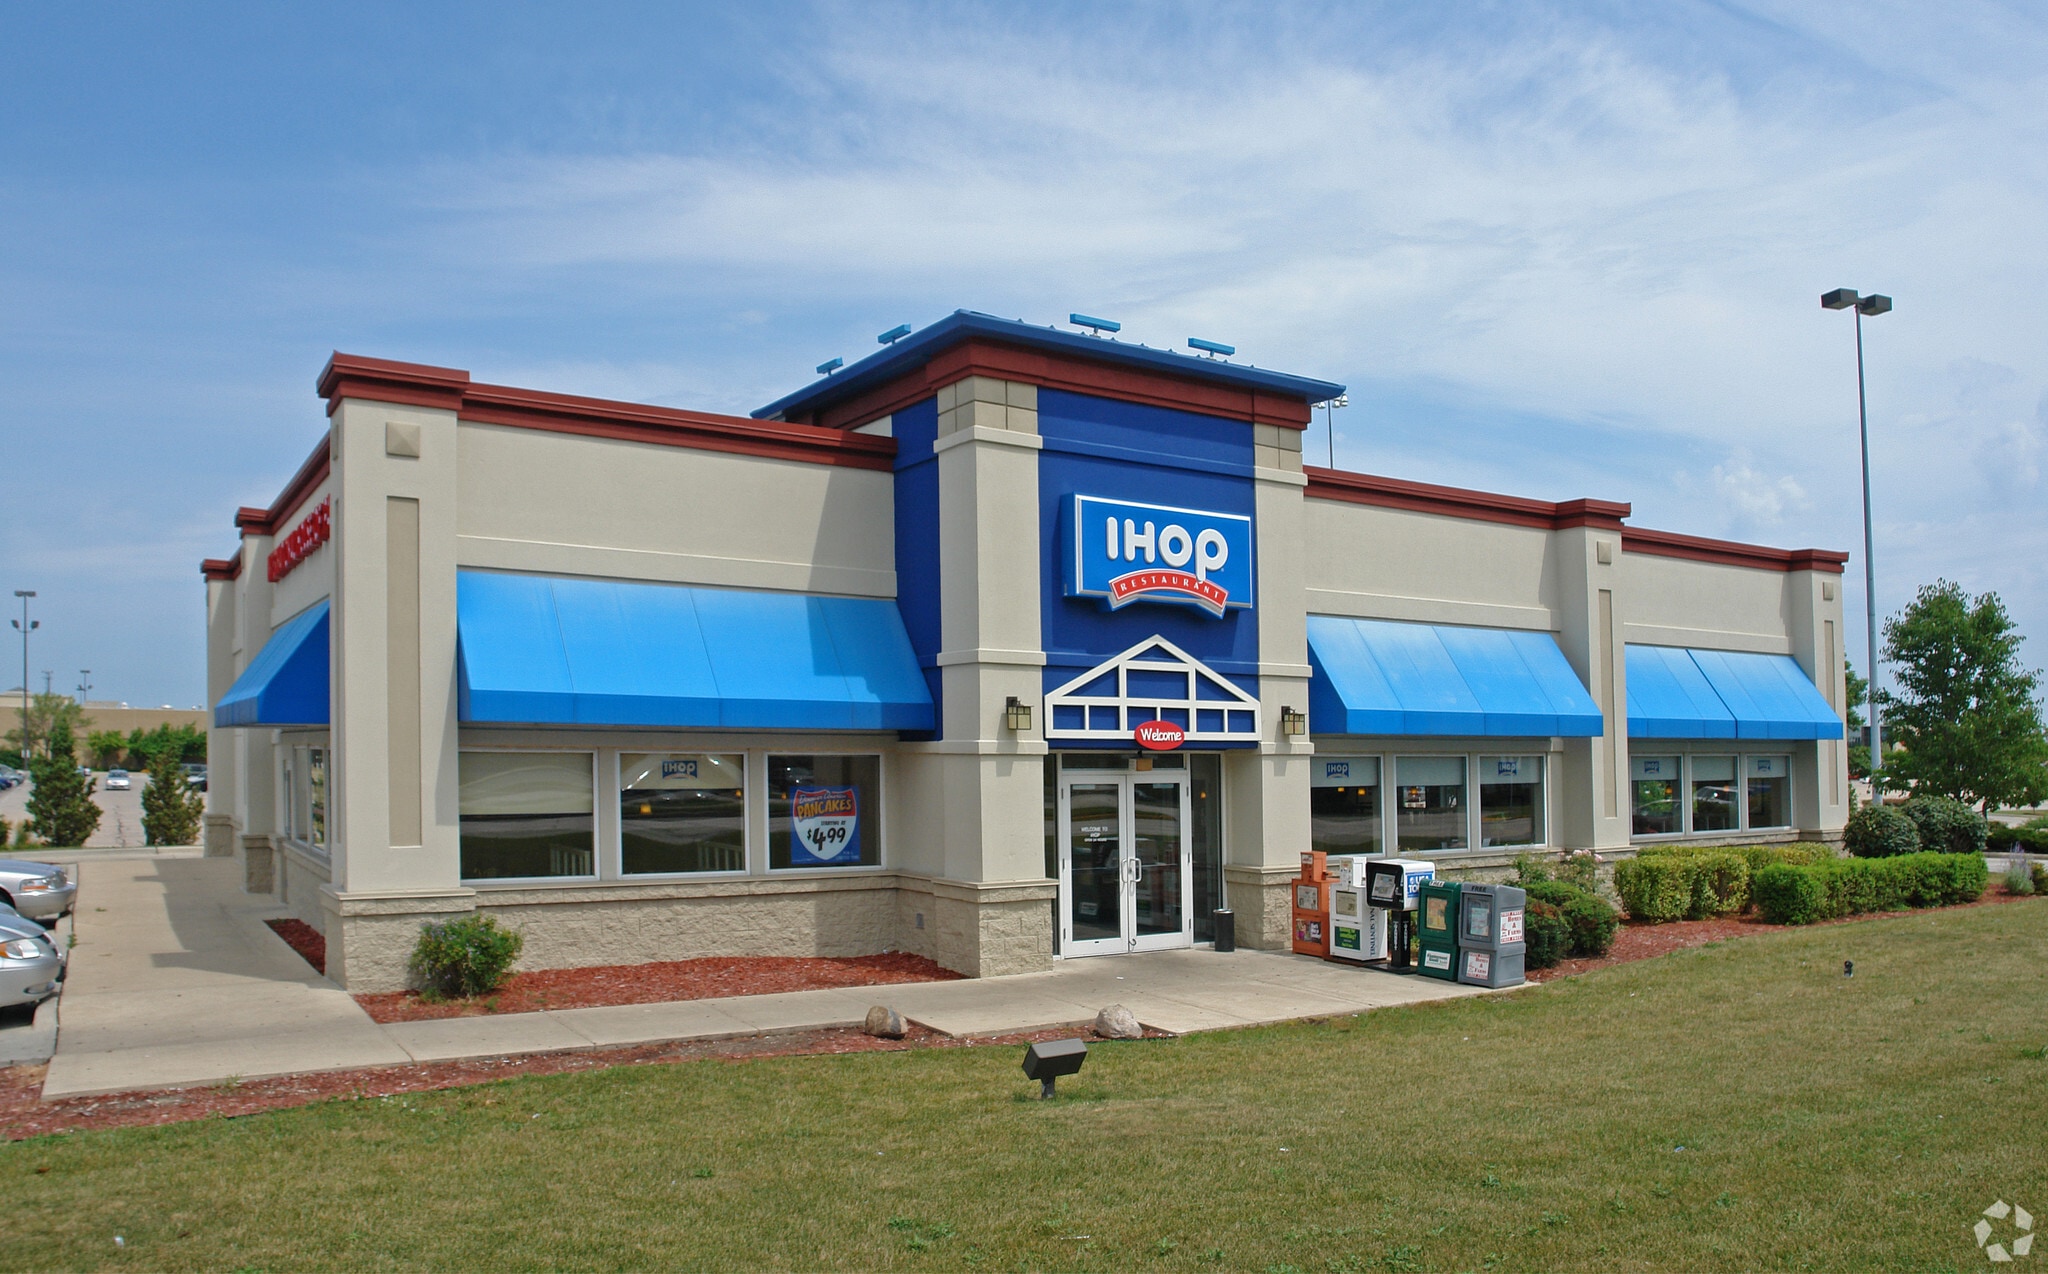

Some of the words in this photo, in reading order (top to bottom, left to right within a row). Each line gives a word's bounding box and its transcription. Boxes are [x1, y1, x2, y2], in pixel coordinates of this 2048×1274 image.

[1107, 517, 1228, 583] IHOP
[1120, 575, 1219, 599] RESTAURANT
[1140, 727, 1182, 742] Welcome
[663, 762, 696, 776] IHOP
[1328, 764, 1348, 774] IHOP
[797, 799, 852, 821] PANCAKES
